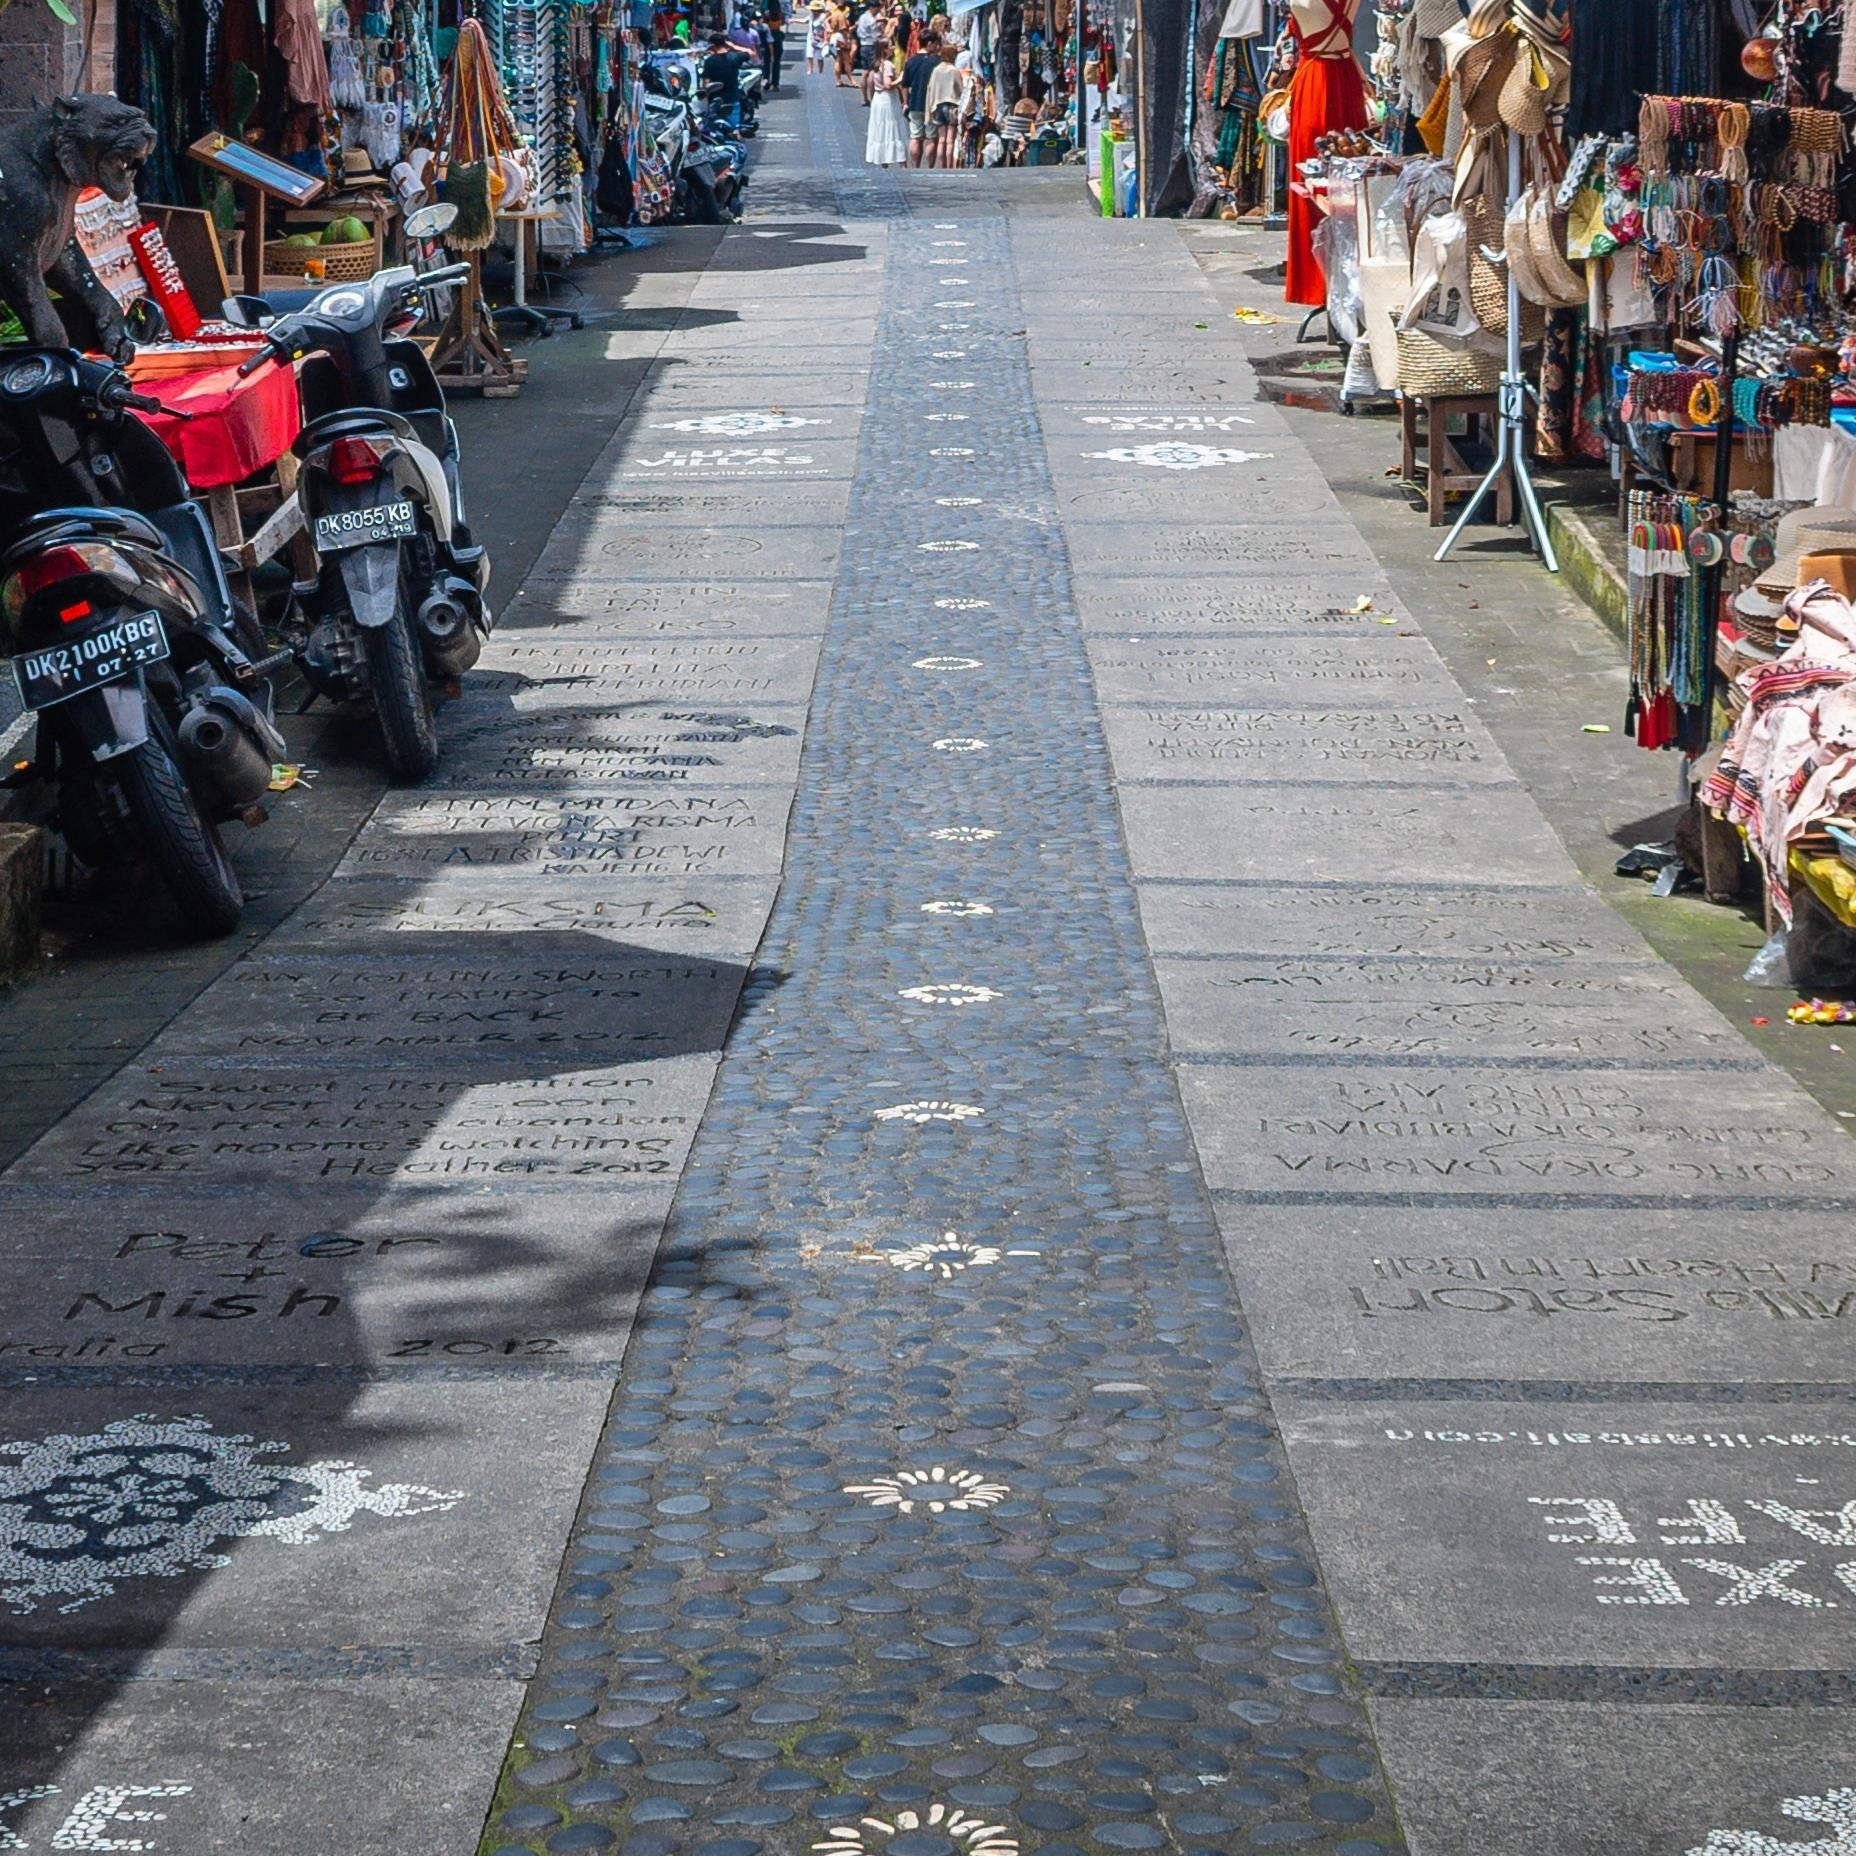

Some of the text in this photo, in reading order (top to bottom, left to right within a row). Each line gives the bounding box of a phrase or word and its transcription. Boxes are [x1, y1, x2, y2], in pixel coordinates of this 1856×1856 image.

[1081, 415, 1255, 424] VILLAS
[1110, 422, 1232, 431] LUXE
[635, 456, 815, 467] VILLAS
[663, 448, 789, 459] LUXE
[318, 503, 412, 535] DK 8055 KB
[631, 814, 760, 828] RISMA
[625, 845, 728, 859] DEWI
[345, 899, 719, 918] SUKSMA
[396, 990, 570, 1002] HAPPY
[408, 1010, 569, 1023] BACK
[155, 1077, 656, 1096] Sweet disposition
[127, 1099, 332, 1113] Never
[468, 1096, 639, 1110] soon
[456, 1116, 687, 1130] abandon
[437, 1135, 676, 1157] watching
[59, 1159, 198, 1177] you
[562, 1159, 673, 1175] 2012
[1271, 1153, 1504, 1176] DARMA
[1516, 1158, 1645, 1179] OKA
[114, 1231, 443, 1262] Peter
[1366, 1255, 1487, 1282] Bali
[1498, 1257, 1568, 1282] in
[1574, 1257, 1786, 1283] Heart
[63, 1287, 342, 1321] Mish
[1345, 1285, 1690, 1323] Satori
[385, 1338, 570, 1357] 2012
